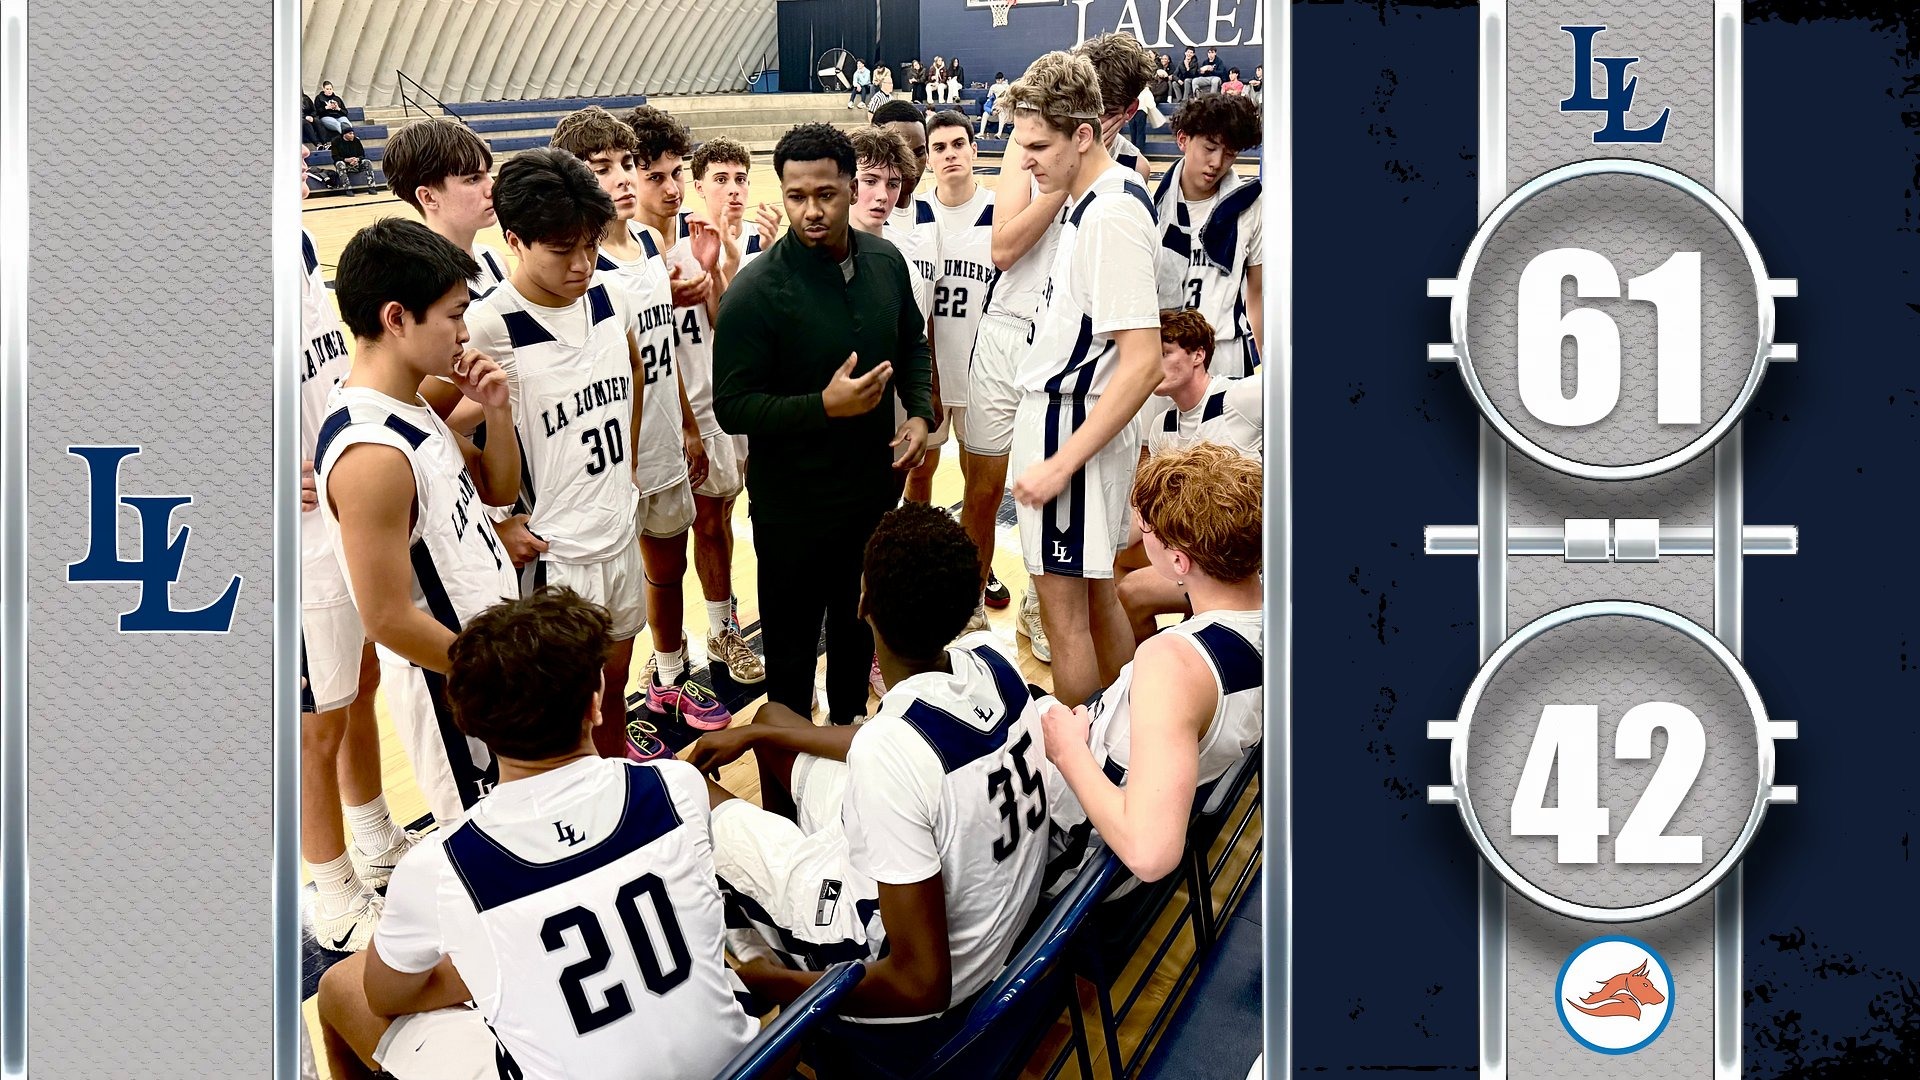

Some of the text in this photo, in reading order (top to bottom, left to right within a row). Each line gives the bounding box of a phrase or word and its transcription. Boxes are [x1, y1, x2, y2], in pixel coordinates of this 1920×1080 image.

[934, 286, 968, 318] 22
[1182, 278, 1203, 310] 3
[640, 336, 672, 385] 24
[541, 402, 569, 438] LA
[581, 417, 624, 476] 30
[987, 729, 1047, 865] 35
[539, 871, 693, 1038] 20
